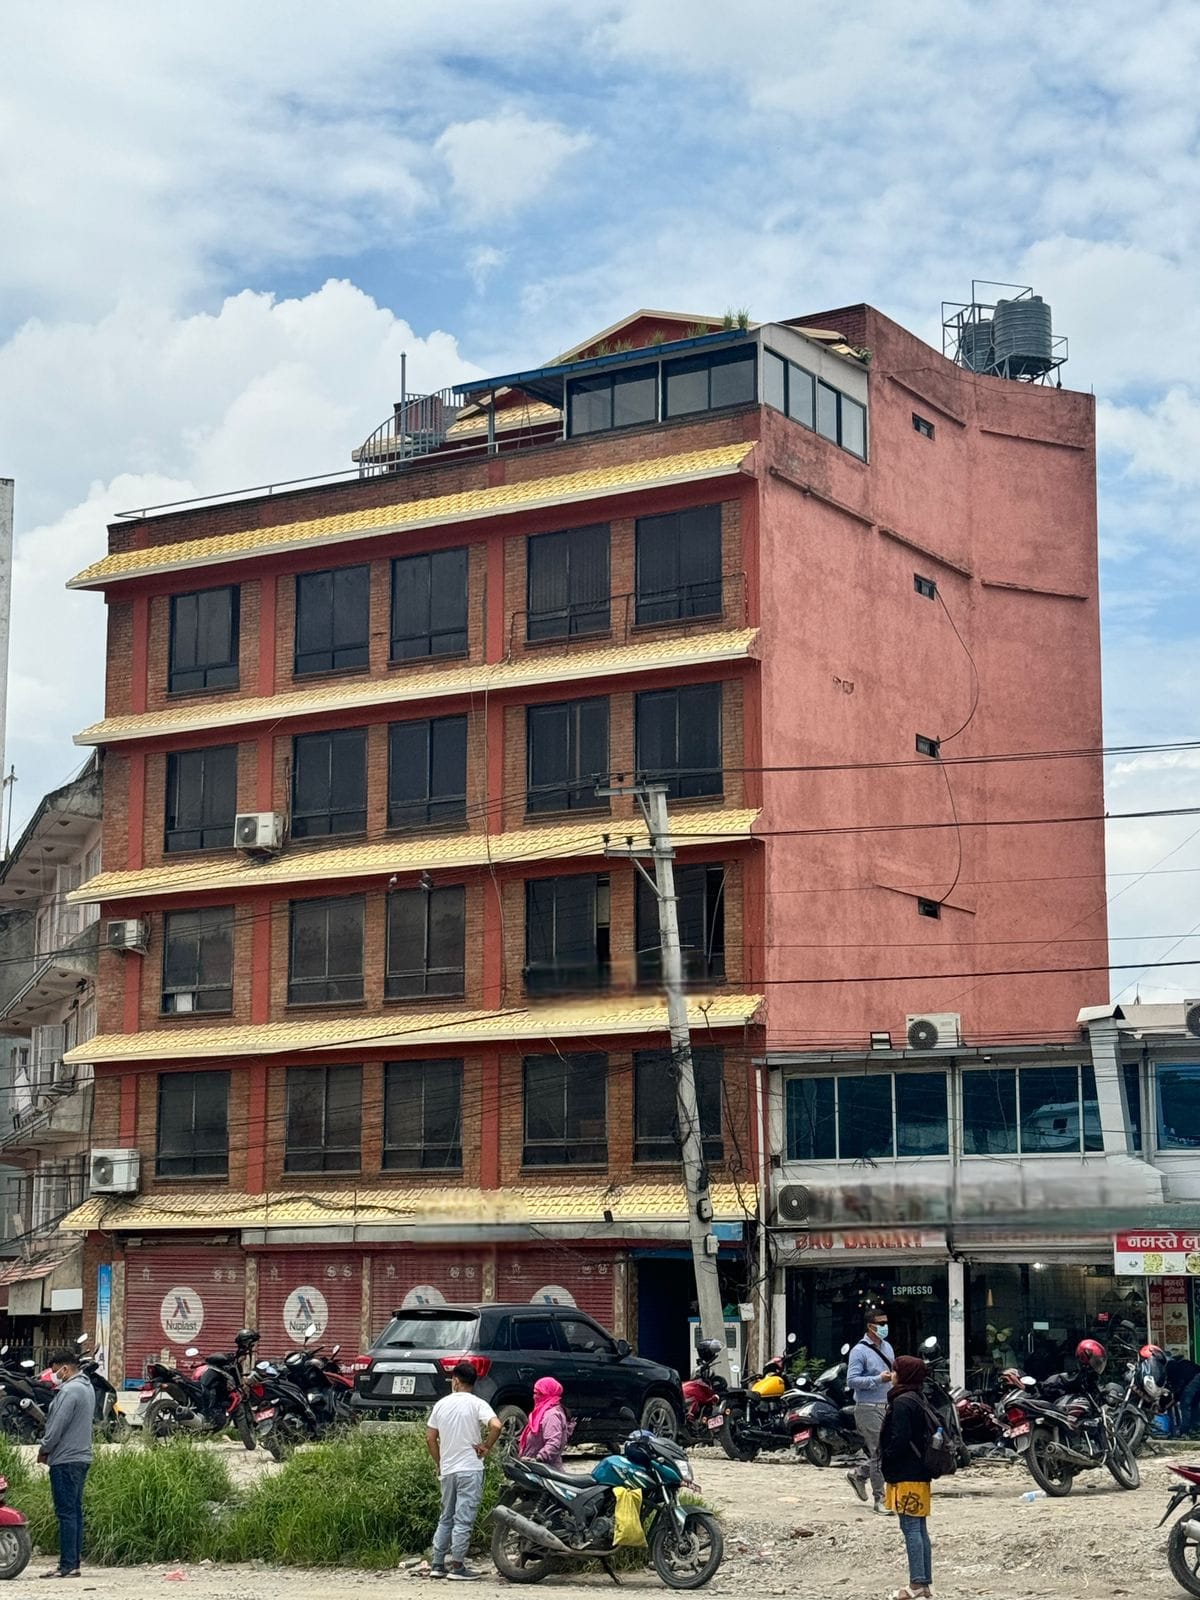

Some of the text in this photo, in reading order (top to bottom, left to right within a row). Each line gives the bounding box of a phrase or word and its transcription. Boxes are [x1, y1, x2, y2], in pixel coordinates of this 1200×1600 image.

[1127, 1232, 1200, 1252] नमस्ते लु
[892, 1286, 933, 1296] ESPRESSO
[166, 1319, 197, 1332] Nuplast
